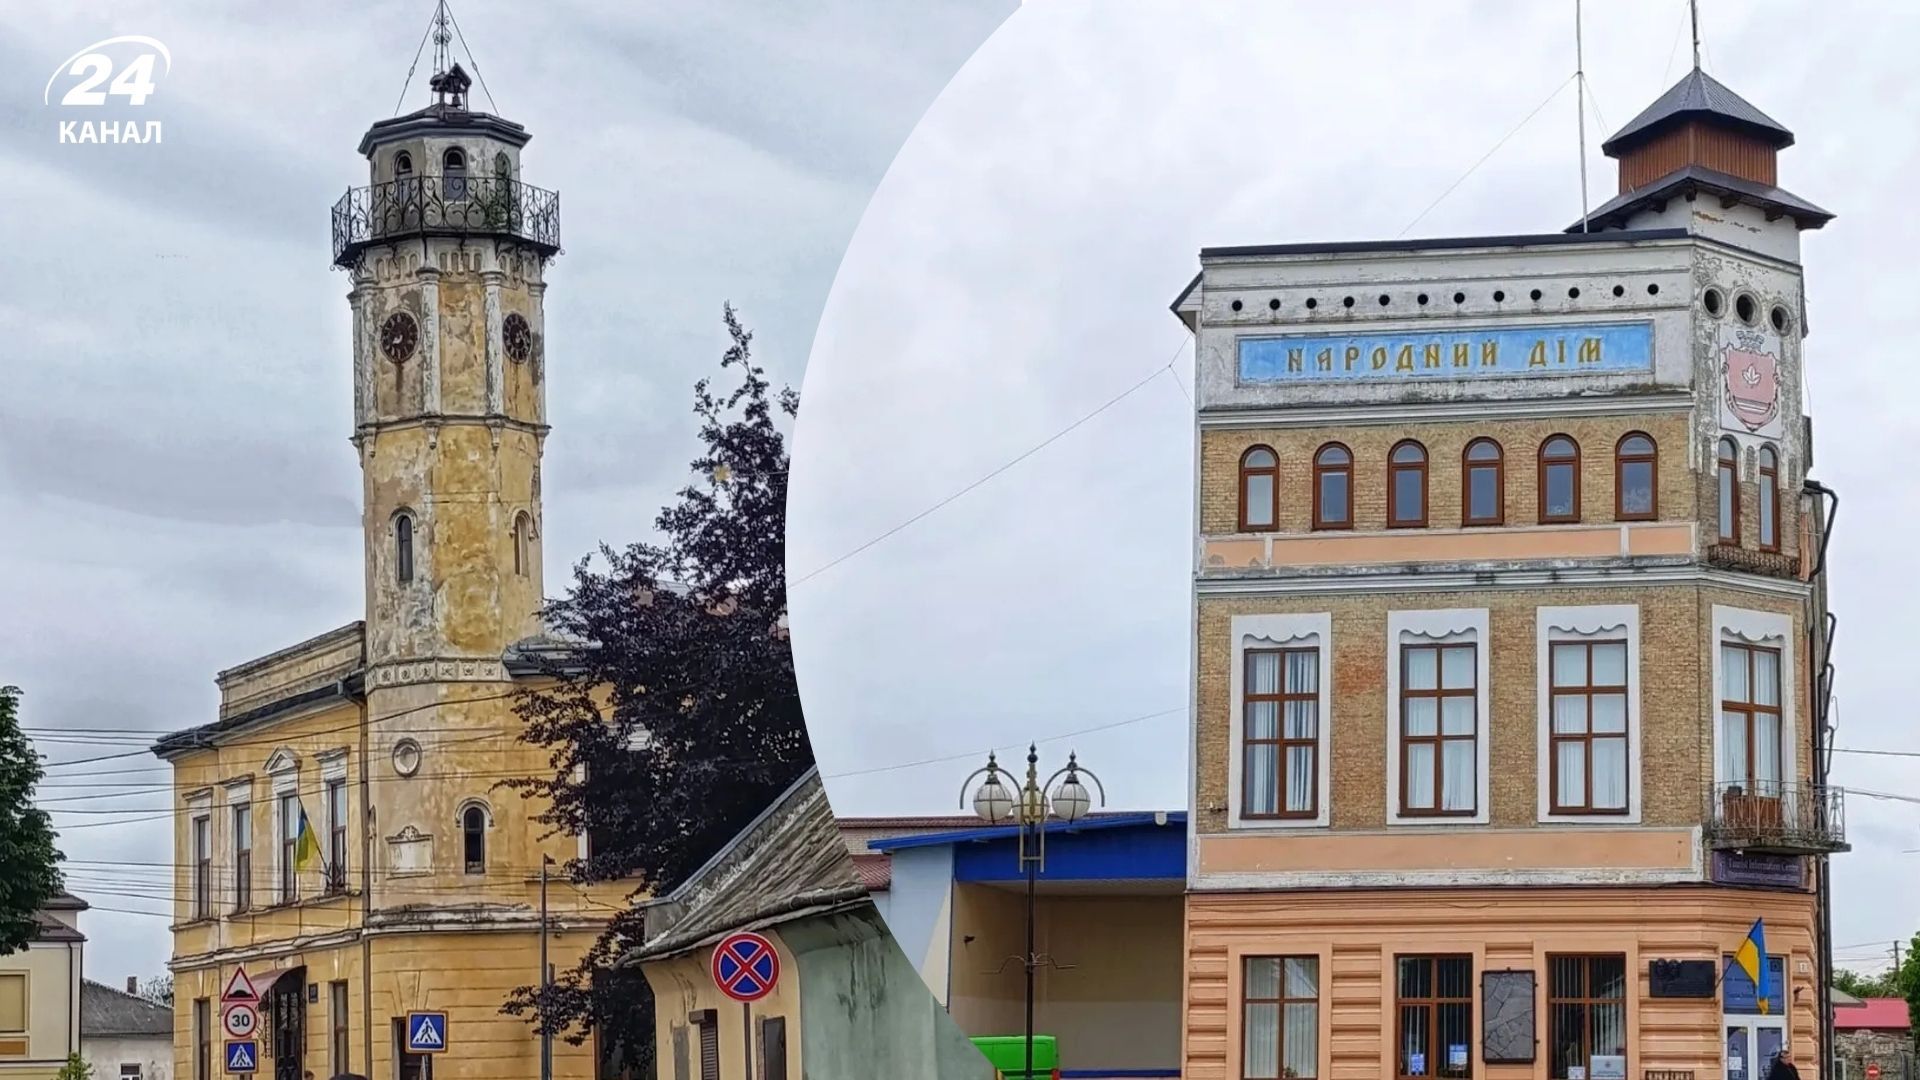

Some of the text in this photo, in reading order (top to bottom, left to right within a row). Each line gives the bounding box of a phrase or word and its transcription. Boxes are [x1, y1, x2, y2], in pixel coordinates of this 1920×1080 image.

[1287, 337, 1602, 372] НАРОДНИЙ ДІМ
[232, 1014, 250, 1027] 30
